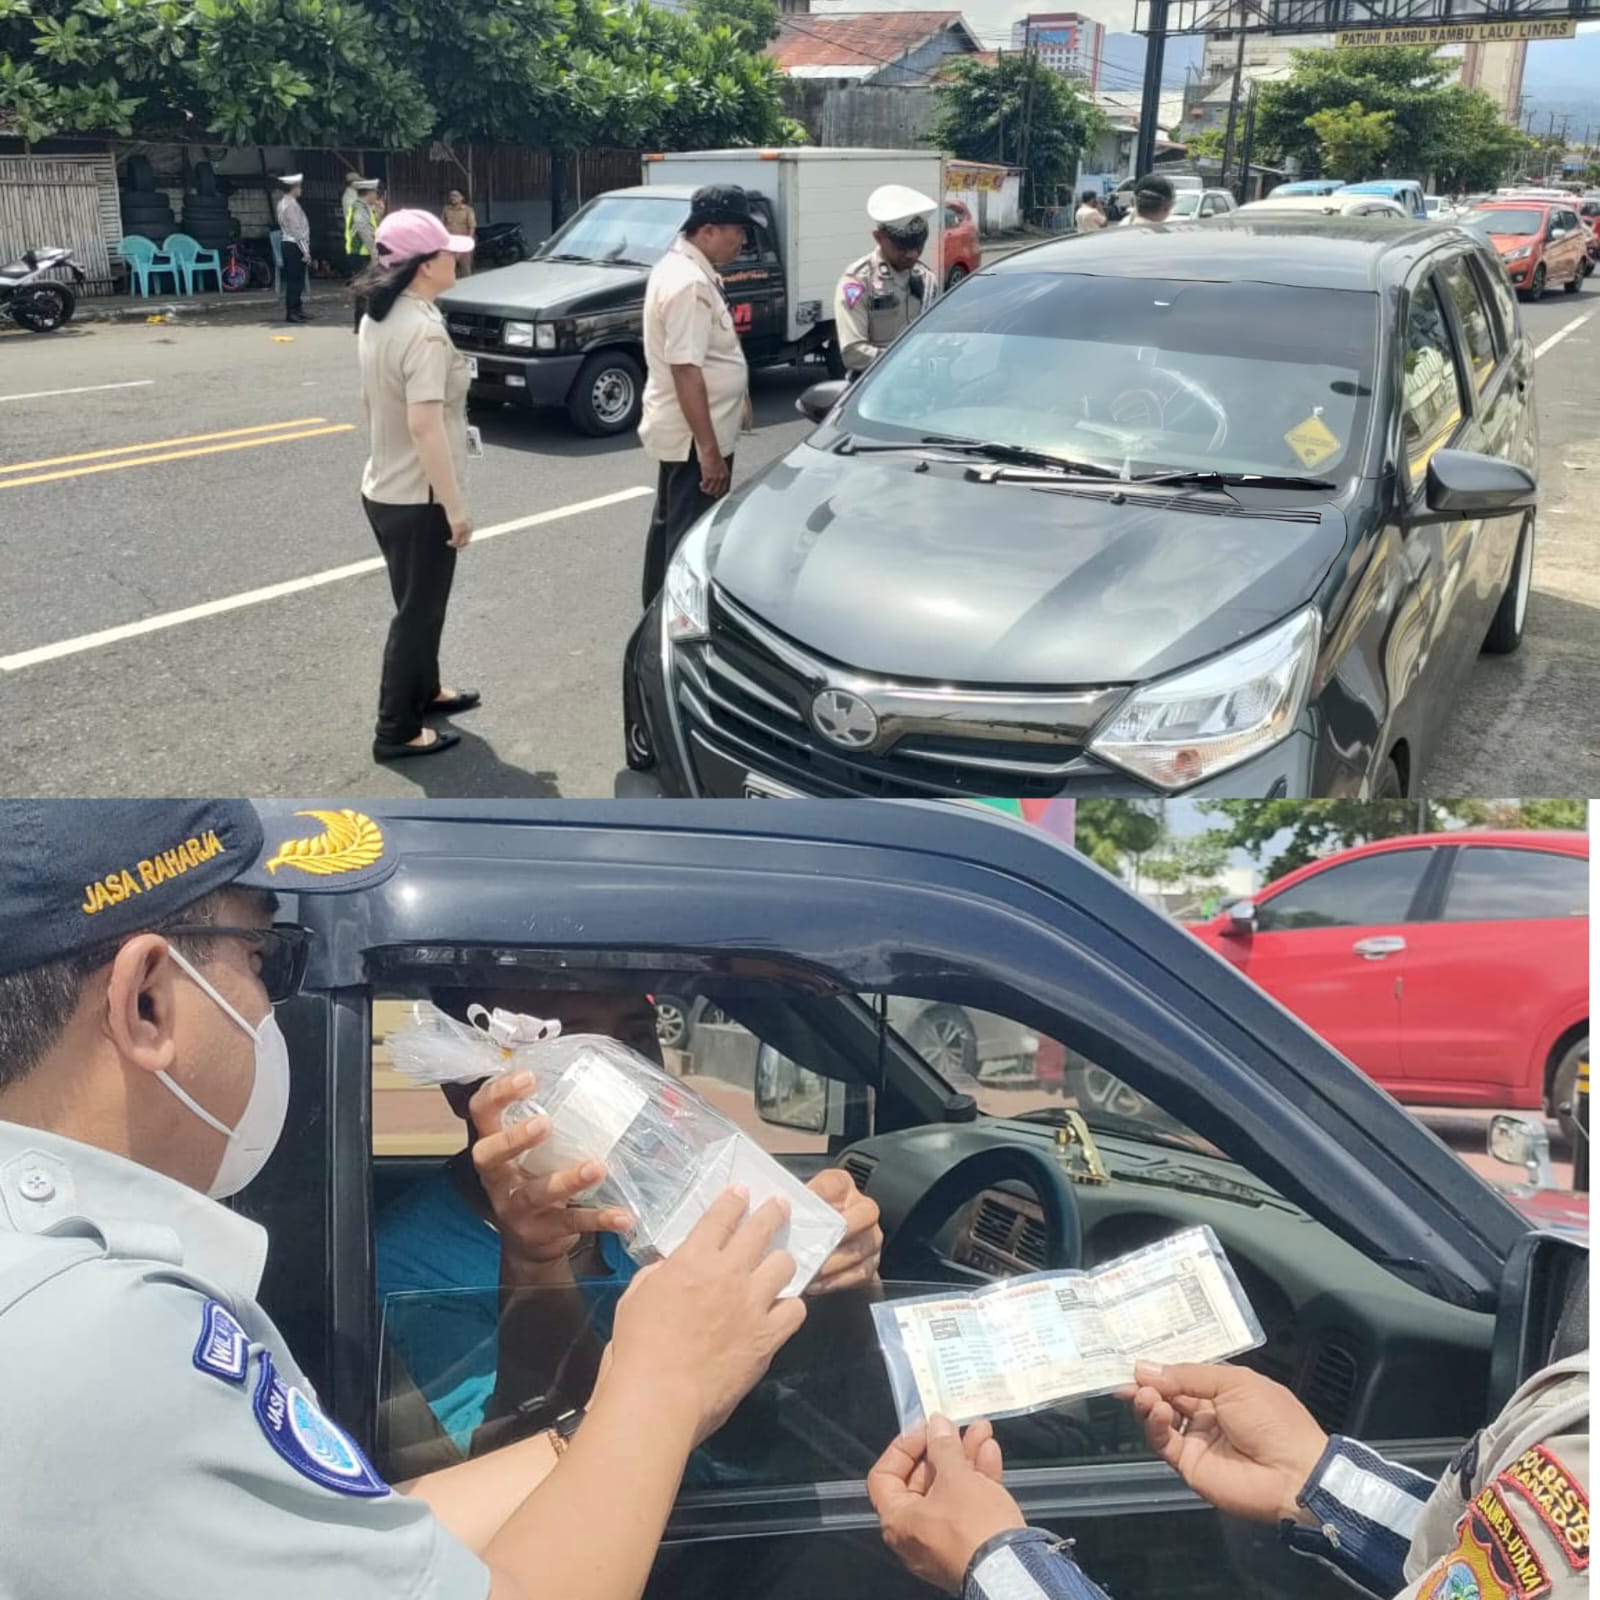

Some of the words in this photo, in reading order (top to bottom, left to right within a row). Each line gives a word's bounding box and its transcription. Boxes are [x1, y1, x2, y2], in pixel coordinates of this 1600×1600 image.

[1342, 32, 1380, 45] PATUHI
[1385, 30, 1426, 43] RAMBU
[1429, 28, 1473, 41] RAMBU
[1480, 25, 1514, 39] LALU
[1520, 22, 1568, 37] LINTAS
[82, 869, 142, 915] JASA
[137, 829, 226, 891] RAHARJA
[1505, 1463, 1582, 1549] MANADO
[1508, 1535, 1542, 1592] UTARA
